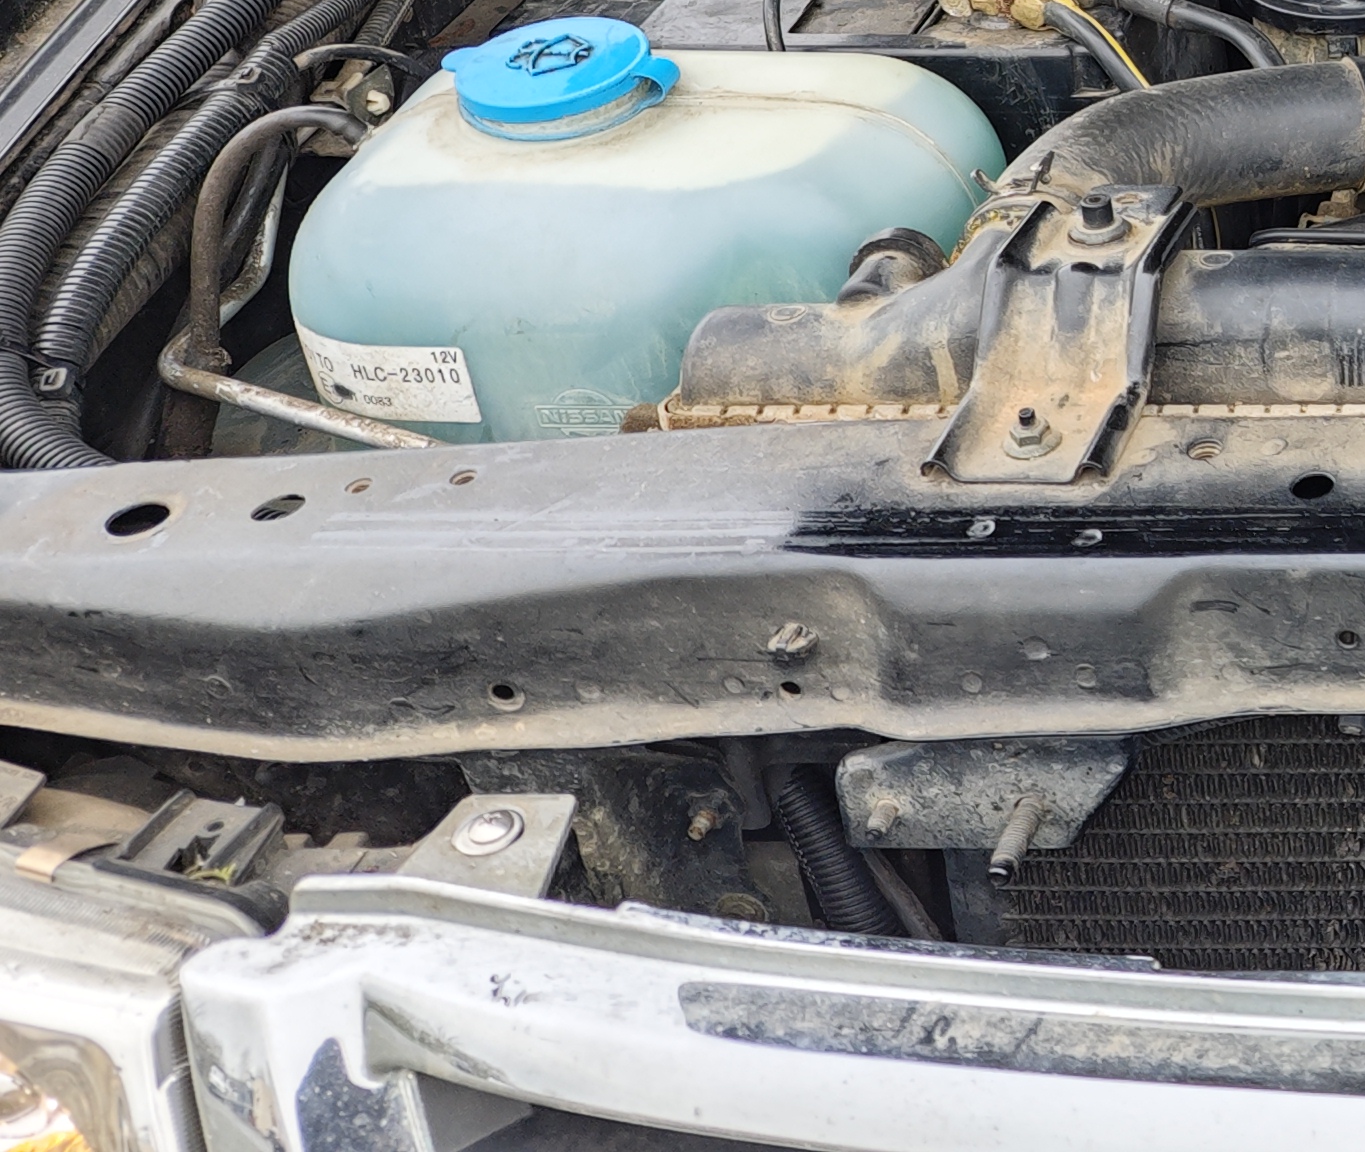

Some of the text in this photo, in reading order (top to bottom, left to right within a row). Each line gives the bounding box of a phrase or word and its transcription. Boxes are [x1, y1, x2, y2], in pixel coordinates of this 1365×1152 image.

[430, 350, 458, 365] 12V
[350, 363, 462, 384] HLC-23010
[540, 408, 628, 425] NISSAN
